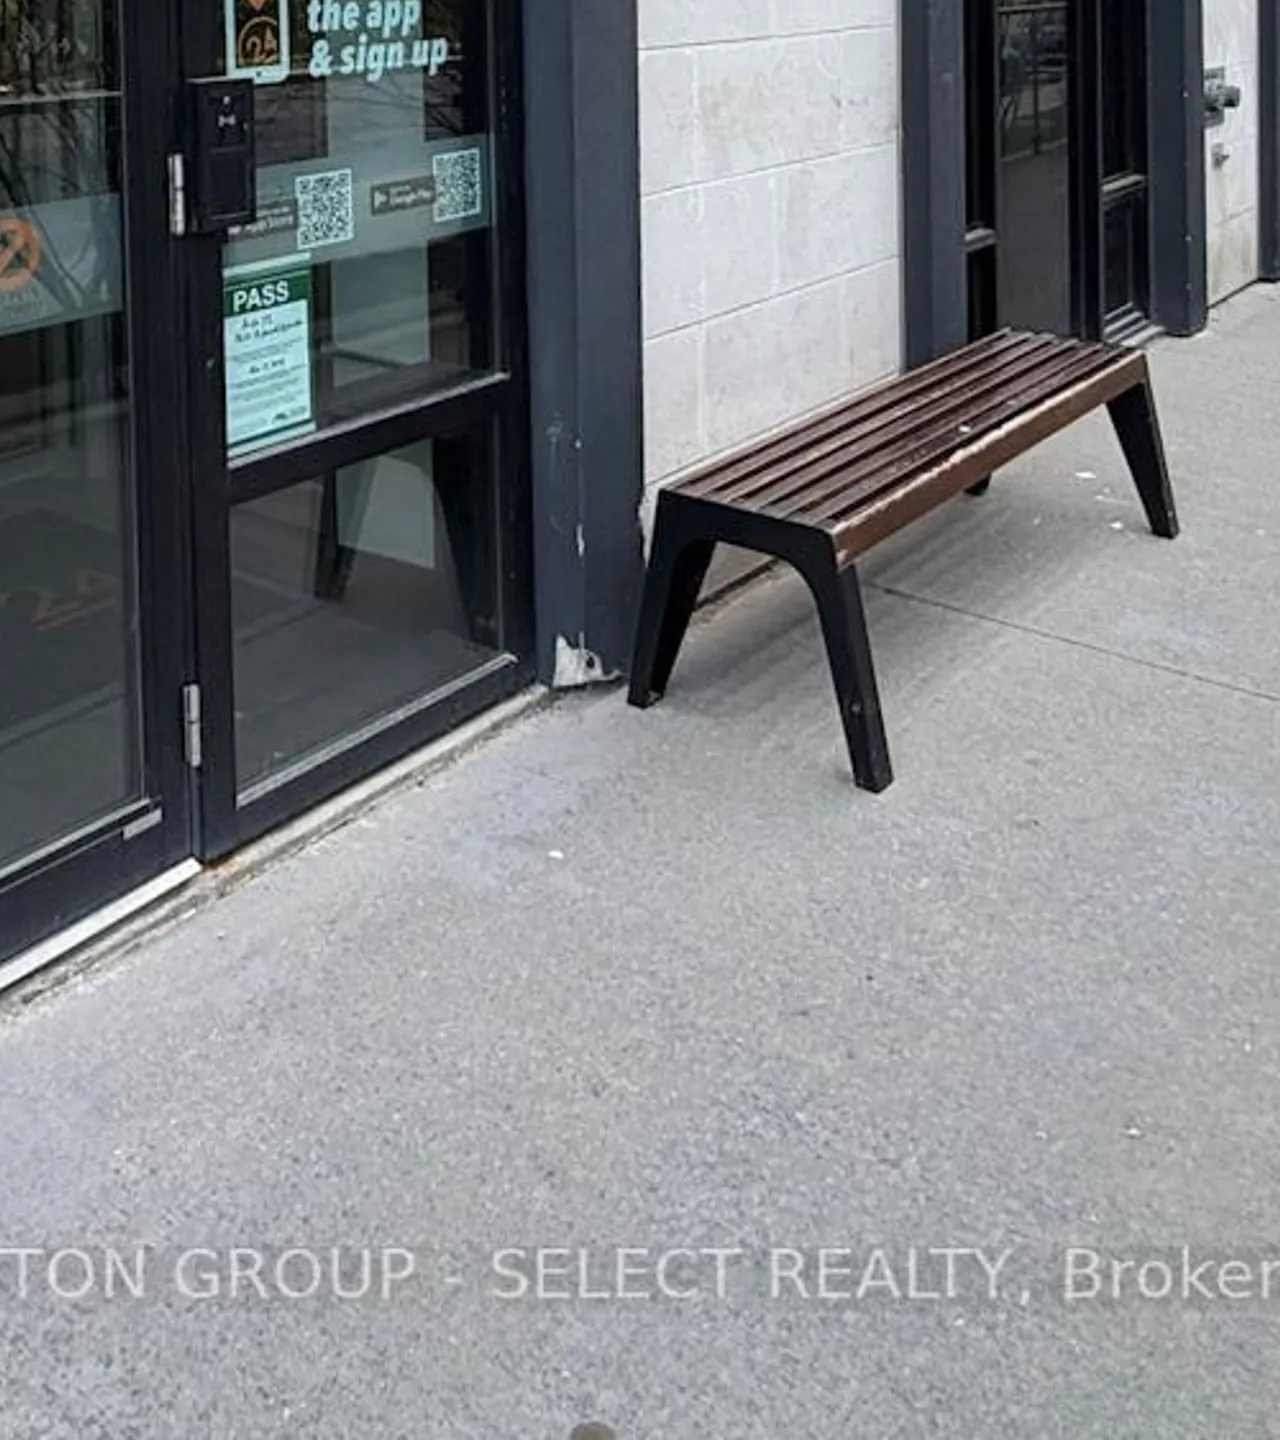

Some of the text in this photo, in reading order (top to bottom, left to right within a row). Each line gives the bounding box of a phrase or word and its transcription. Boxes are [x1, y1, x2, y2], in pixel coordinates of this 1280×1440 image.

[308, 33, 448, 82] & sign up
[232, 280, 290, 313] PASS
